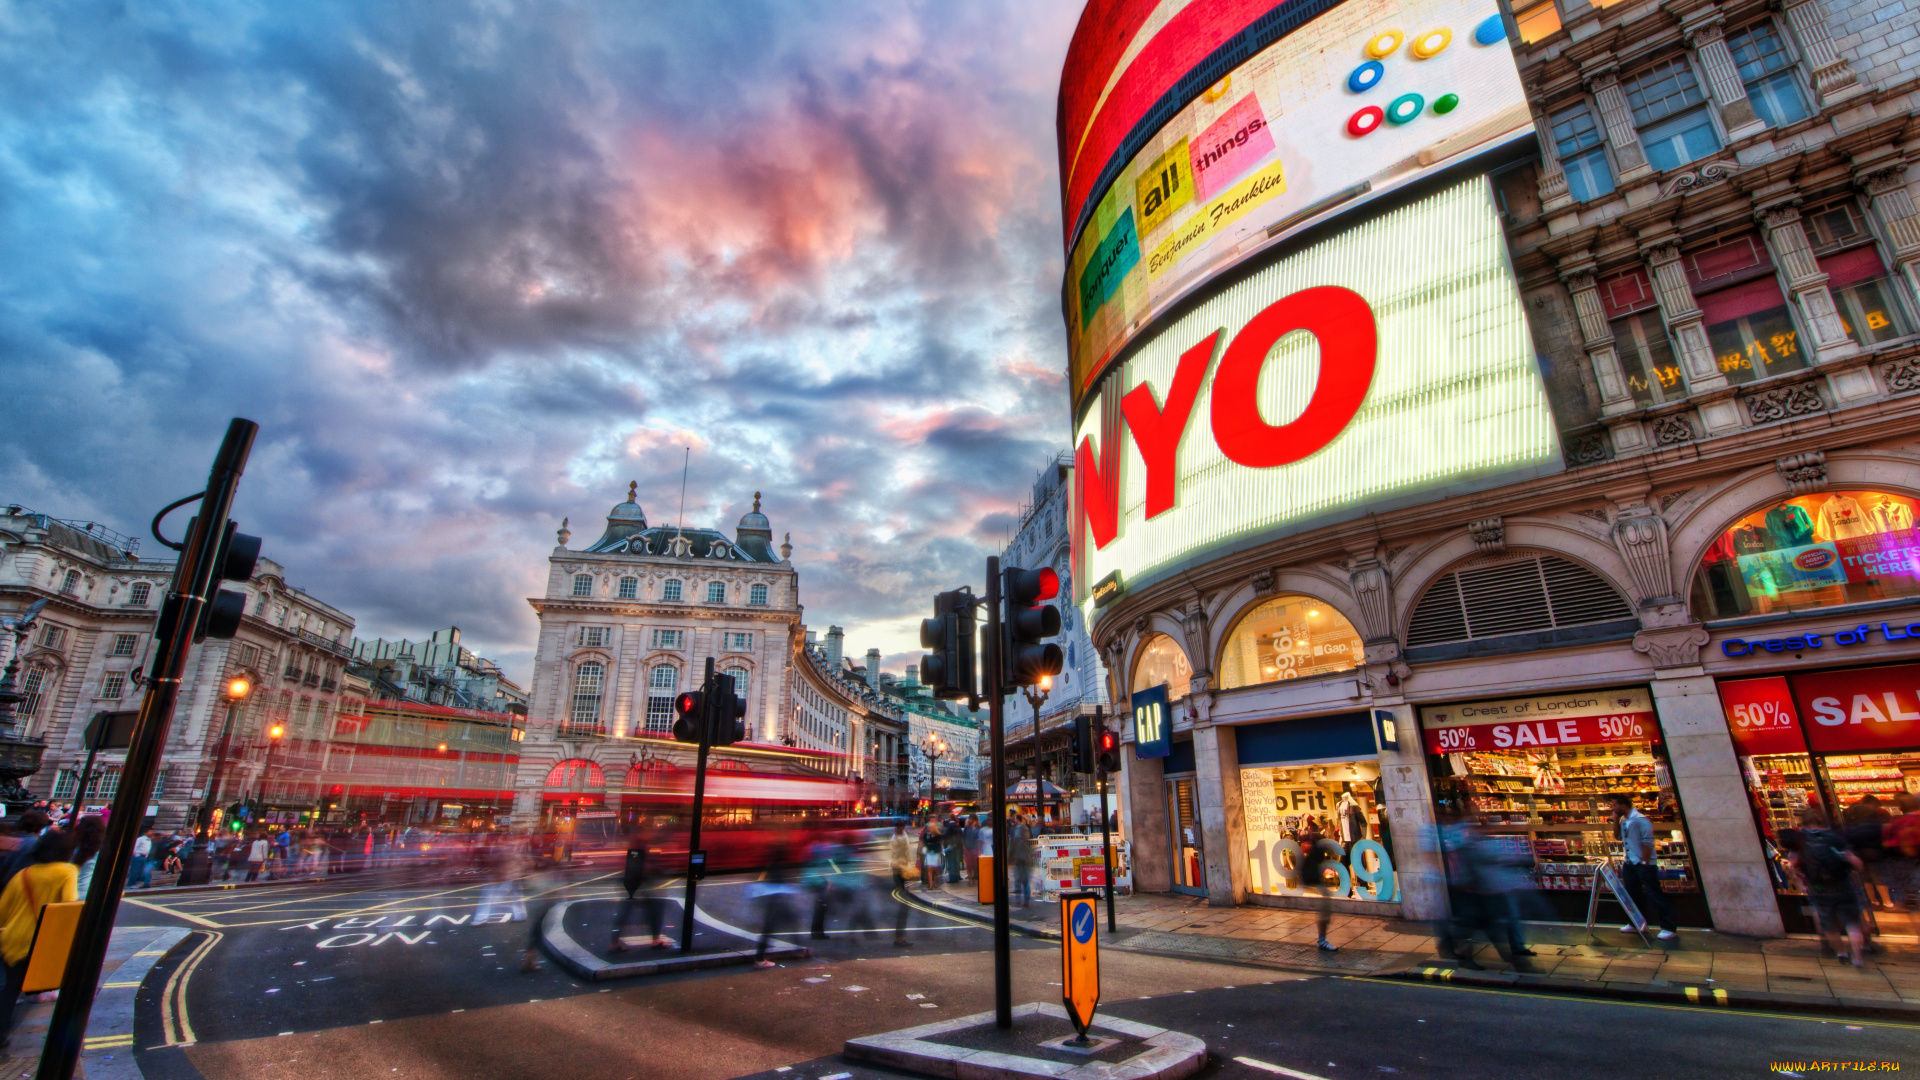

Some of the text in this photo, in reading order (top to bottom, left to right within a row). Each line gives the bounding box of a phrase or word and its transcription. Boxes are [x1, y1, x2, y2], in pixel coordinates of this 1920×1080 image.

[1196, 119, 1267, 173] things.
[1144, 162, 1179, 217] all
[1149, 173, 1281, 274] Benjamin Franklin
[1084, 227, 1132, 310] conquer
[1841, 529, 1914, 548] SIGHTSEEING TOURS
[1898, 537, 1914, 547] BUS
[1800, 550, 1827, 560] OFFICIAL
[1805, 555, 1826, 564] AGENT
[1843, 546, 1920, 567] TICKETS
[1324, 643, 1349, 654] Gap.
[1722, 633, 1822, 656] Crest
[1835, 624, 1869, 645] of
[1462, 698, 1598, 717] Crest of London
[1733, 700, 1790, 727] 50%
[1811, 690, 1920, 727] SAL
[1137, 702, 1161, 744] GAP
[1598, 715, 1643, 738] 50%
[1439, 728, 1476, 748] 50%
[1492, 720, 1581, 748] SALE
[1242, 780, 1274, 788] London.
[1243, 788, 1265, 796] Paris.
[1245, 797, 1261, 805] New
[1245, 805, 1271, 815] Tokyo.
[1291, 790, 1327, 811] Fit
[1248, 823, 1262, 831] Los
[278, 912, 514, 931] ENTRY
[316, 930, 431, 949] NO
